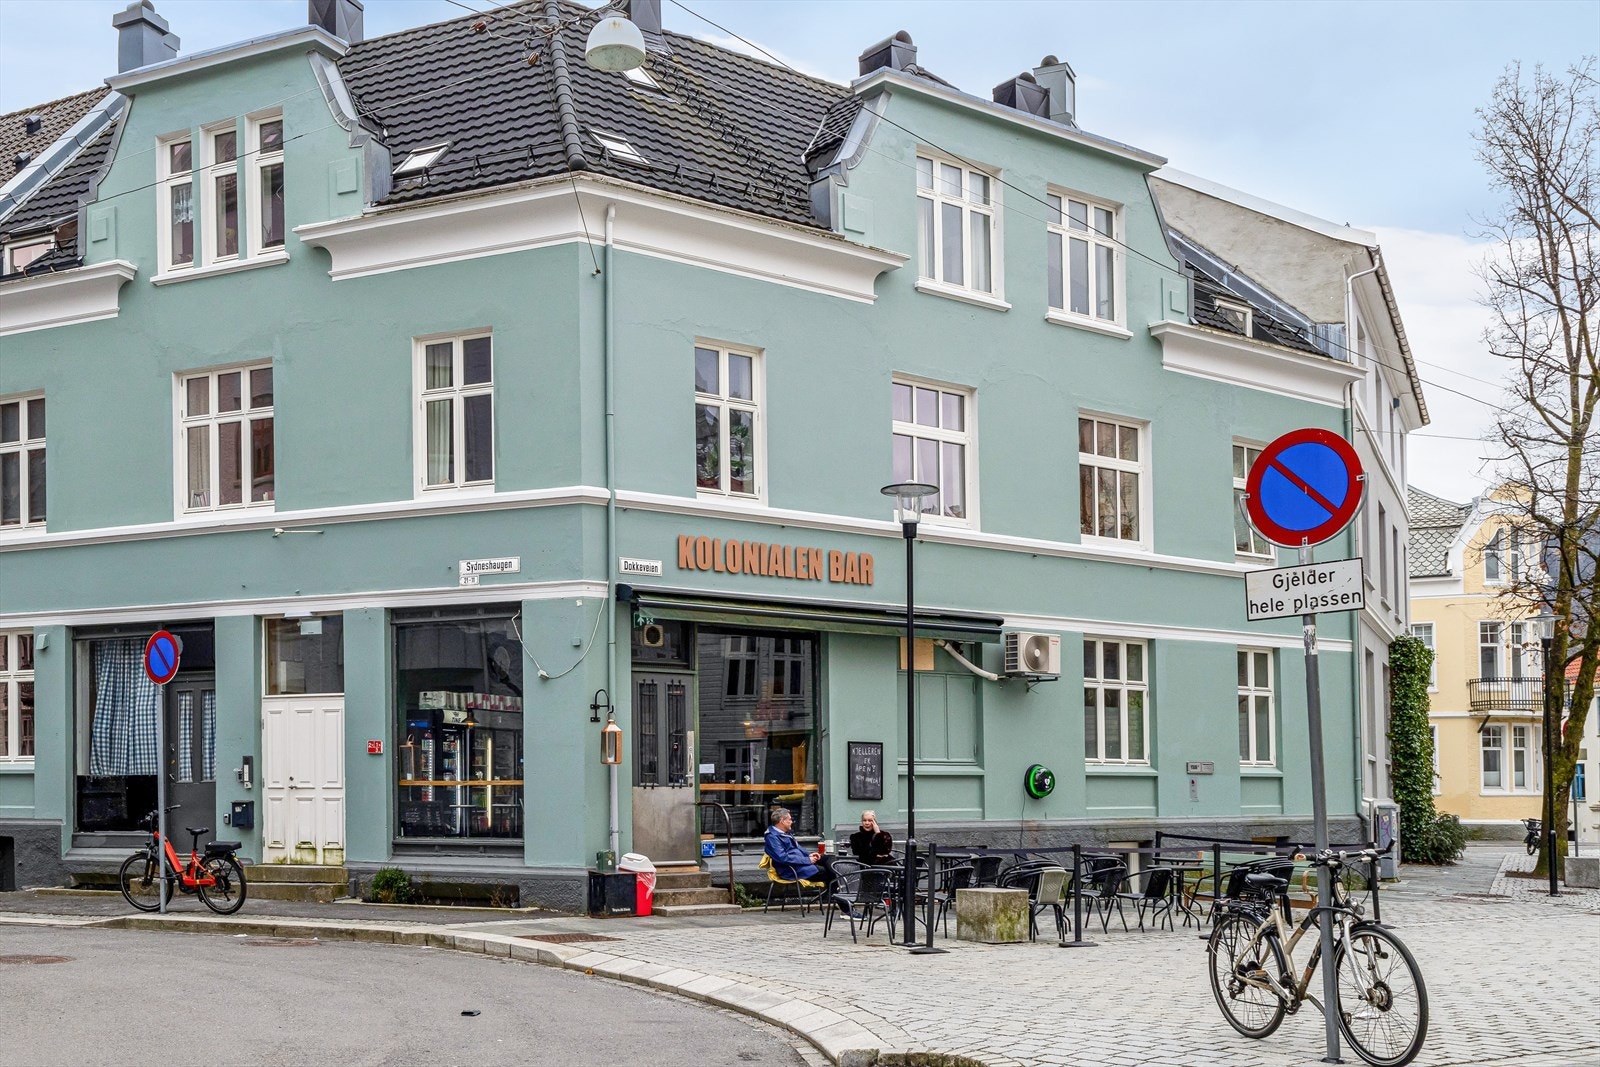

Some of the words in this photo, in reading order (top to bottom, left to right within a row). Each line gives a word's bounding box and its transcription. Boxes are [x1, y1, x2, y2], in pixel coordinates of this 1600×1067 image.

[466, 561, 513, 573] Sydneshaugen
[624, 561, 659, 573] Dokkeveien
[678, 534, 823, 581] KOLONIALEN
[829, 549, 874, 585] BAR
[1272, 569, 1336, 592] Gjelder
[1249, 597, 1284, 614] hele
[1293, 591, 1362, 614] plassen
